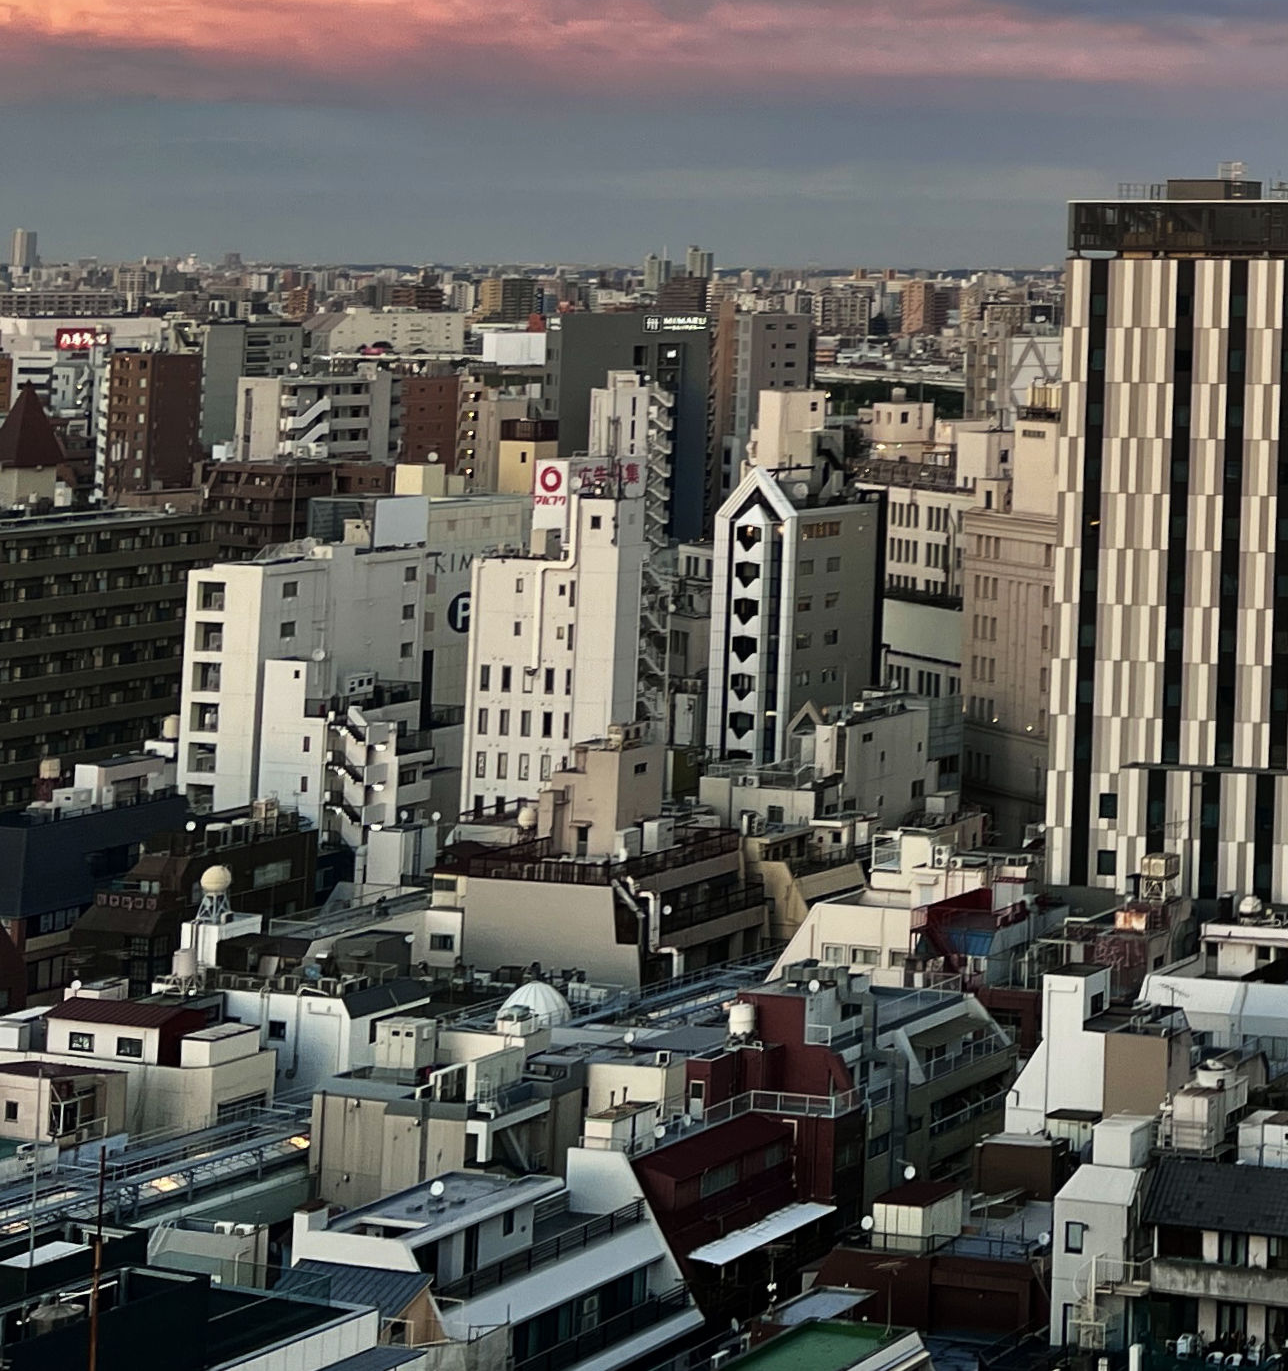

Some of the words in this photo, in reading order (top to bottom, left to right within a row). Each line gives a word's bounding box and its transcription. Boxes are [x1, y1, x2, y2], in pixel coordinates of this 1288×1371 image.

[578, 462, 640, 487] 広告集
[456, 598, 471, 629] P
